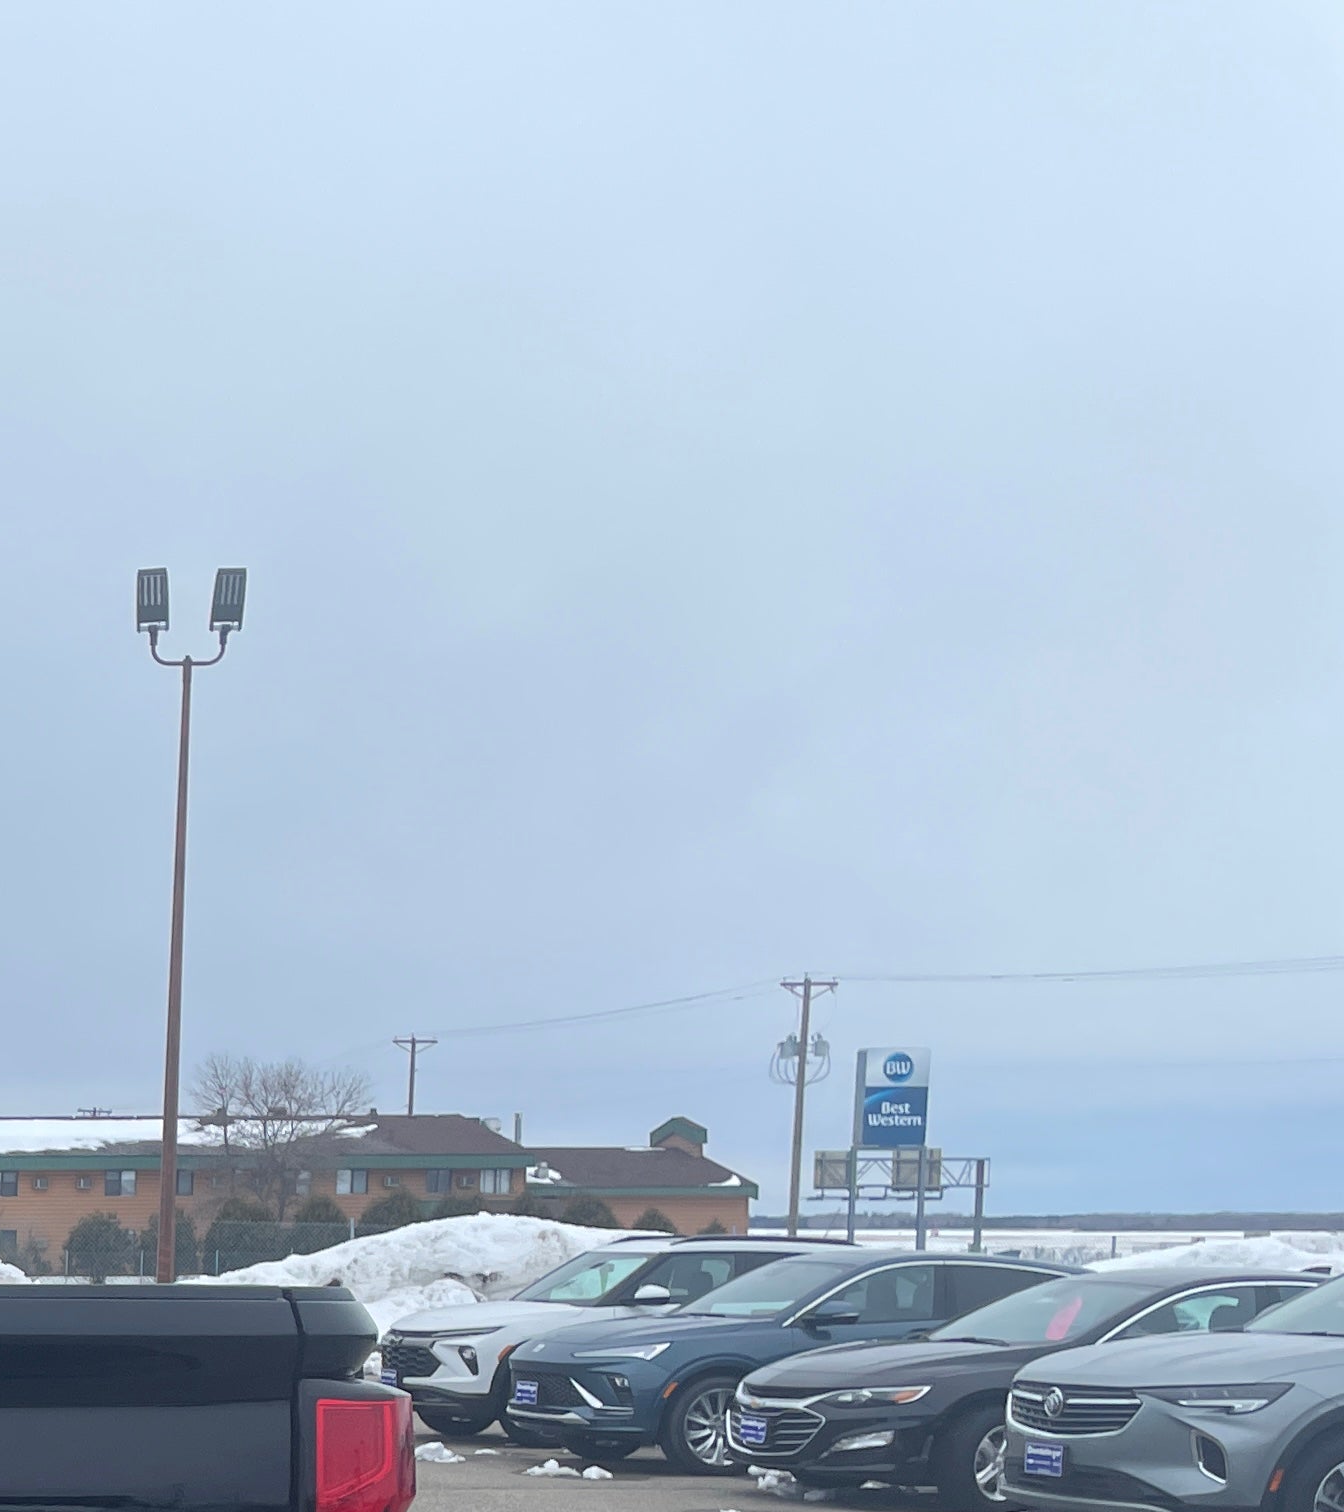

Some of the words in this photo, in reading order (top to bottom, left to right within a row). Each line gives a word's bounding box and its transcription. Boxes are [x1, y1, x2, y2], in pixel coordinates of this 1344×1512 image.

[886, 1061, 911, 1075] BW
[881, 1101, 911, 1114] Best
[868, 1113, 921, 1126] Western
